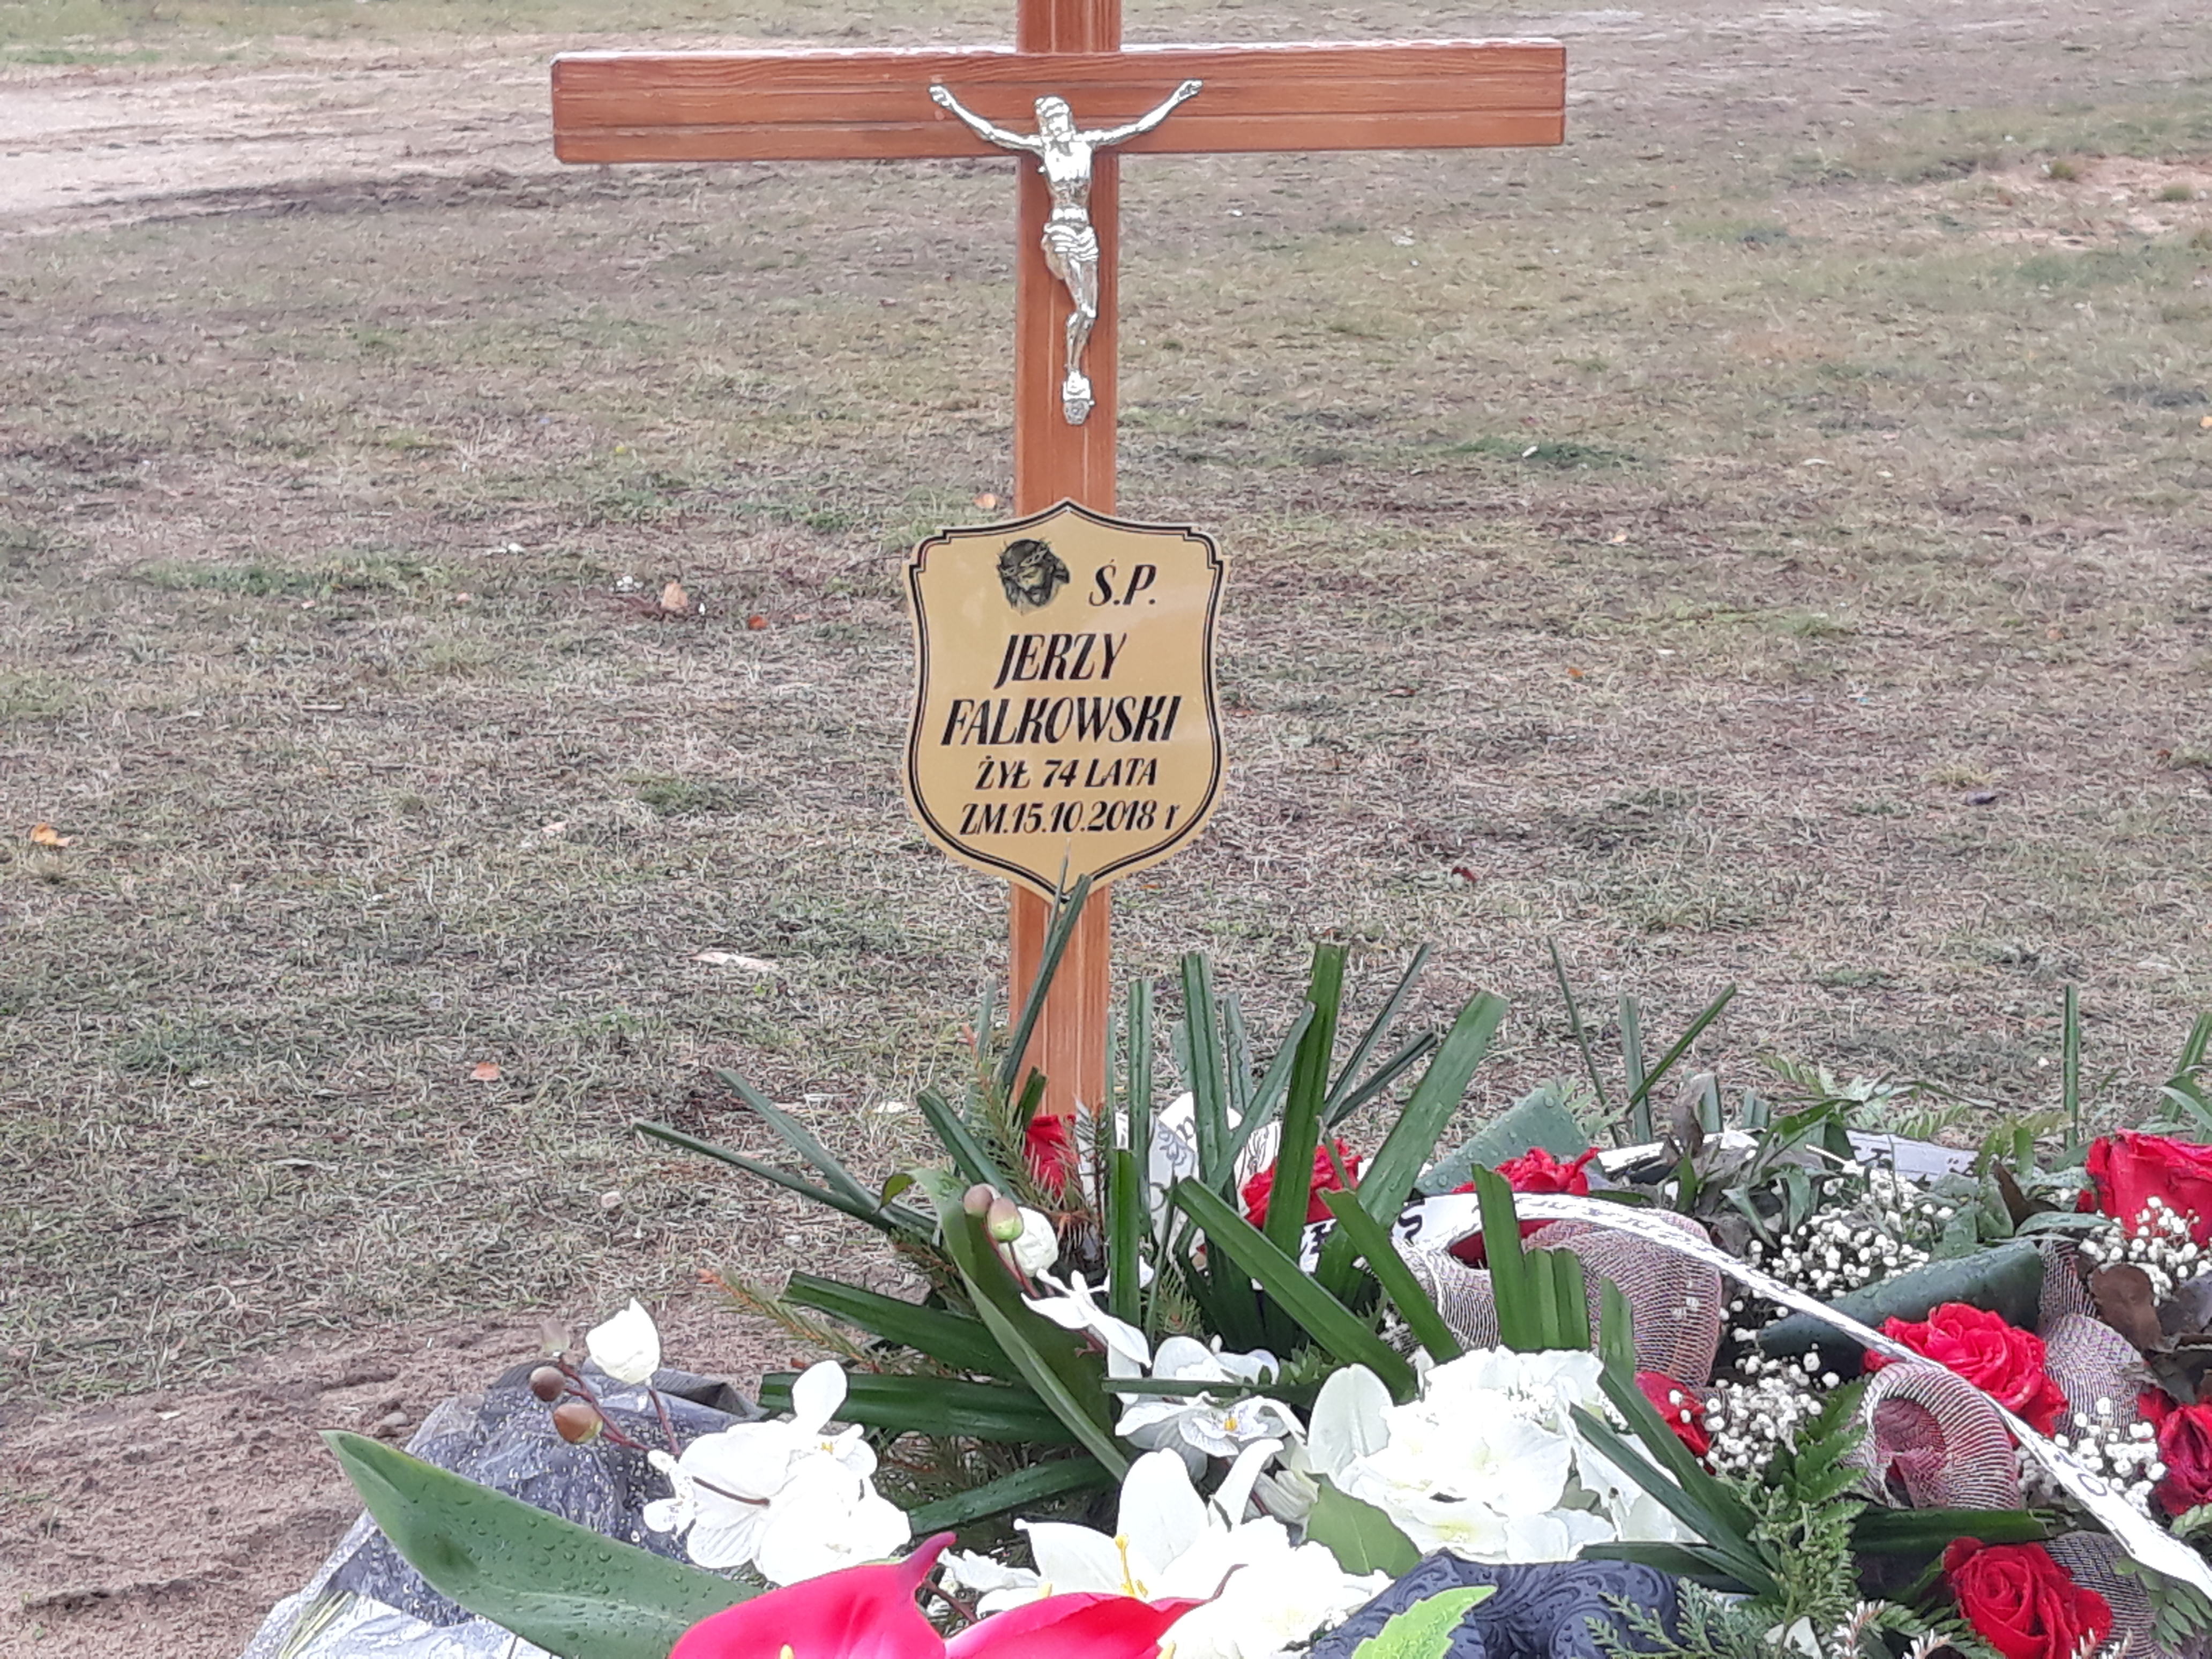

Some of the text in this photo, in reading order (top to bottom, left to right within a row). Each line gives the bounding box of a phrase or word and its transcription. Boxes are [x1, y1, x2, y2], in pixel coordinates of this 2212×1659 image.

[1089, 559, 1156, 607] Ś.P.
[994, 633, 1127, 690] JERZY
[940, 696, 1182, 745] FALKOWSKI
[975, 755, 1157, 790] ŻYŁ 74 LATA
